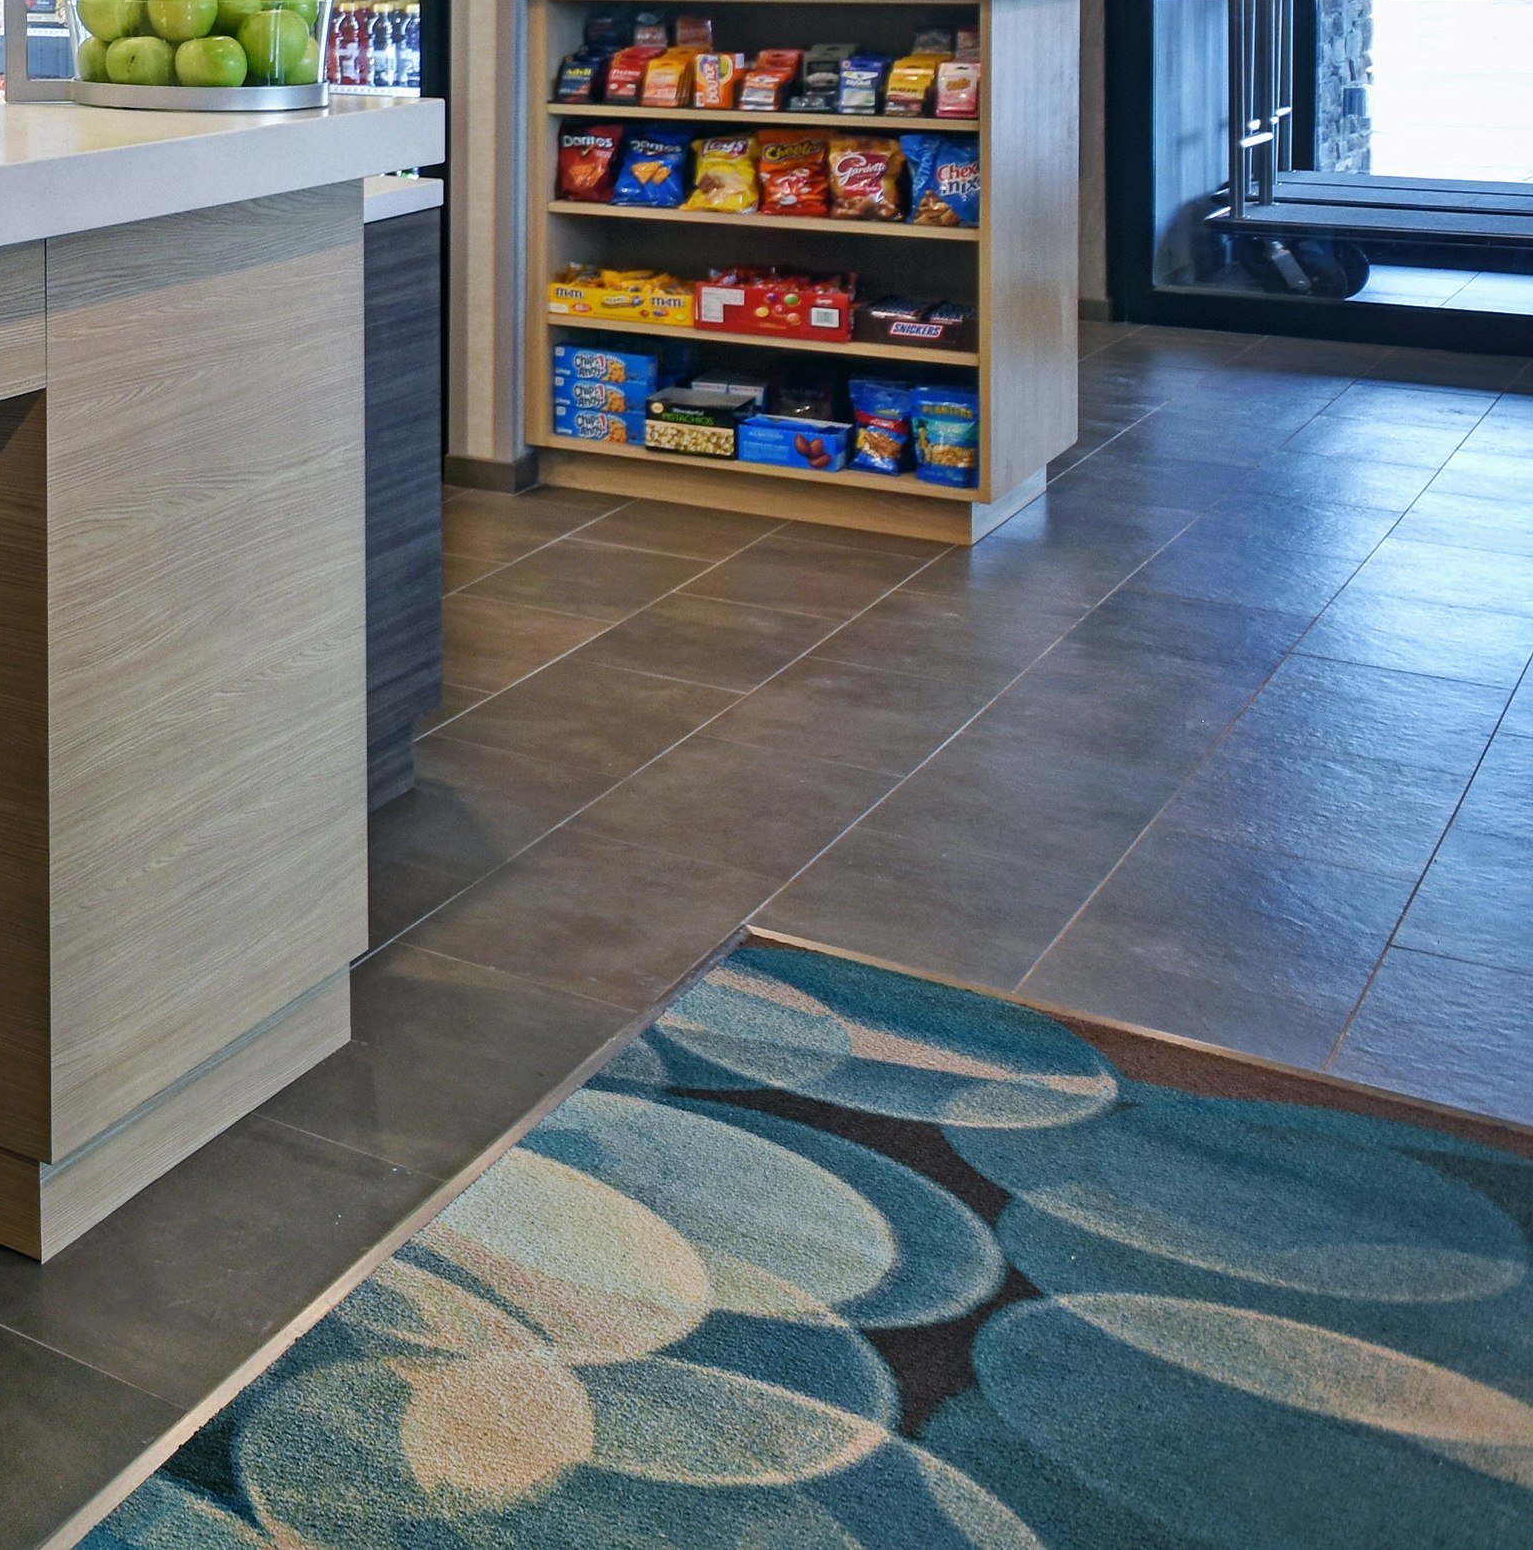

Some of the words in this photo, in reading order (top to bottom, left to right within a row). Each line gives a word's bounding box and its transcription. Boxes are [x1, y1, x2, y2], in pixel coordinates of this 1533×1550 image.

[562, 135, 614, 148] Doritos
[936, 163, 980, 182] Chex
[893, 323, 941, 336] SNICKERS
